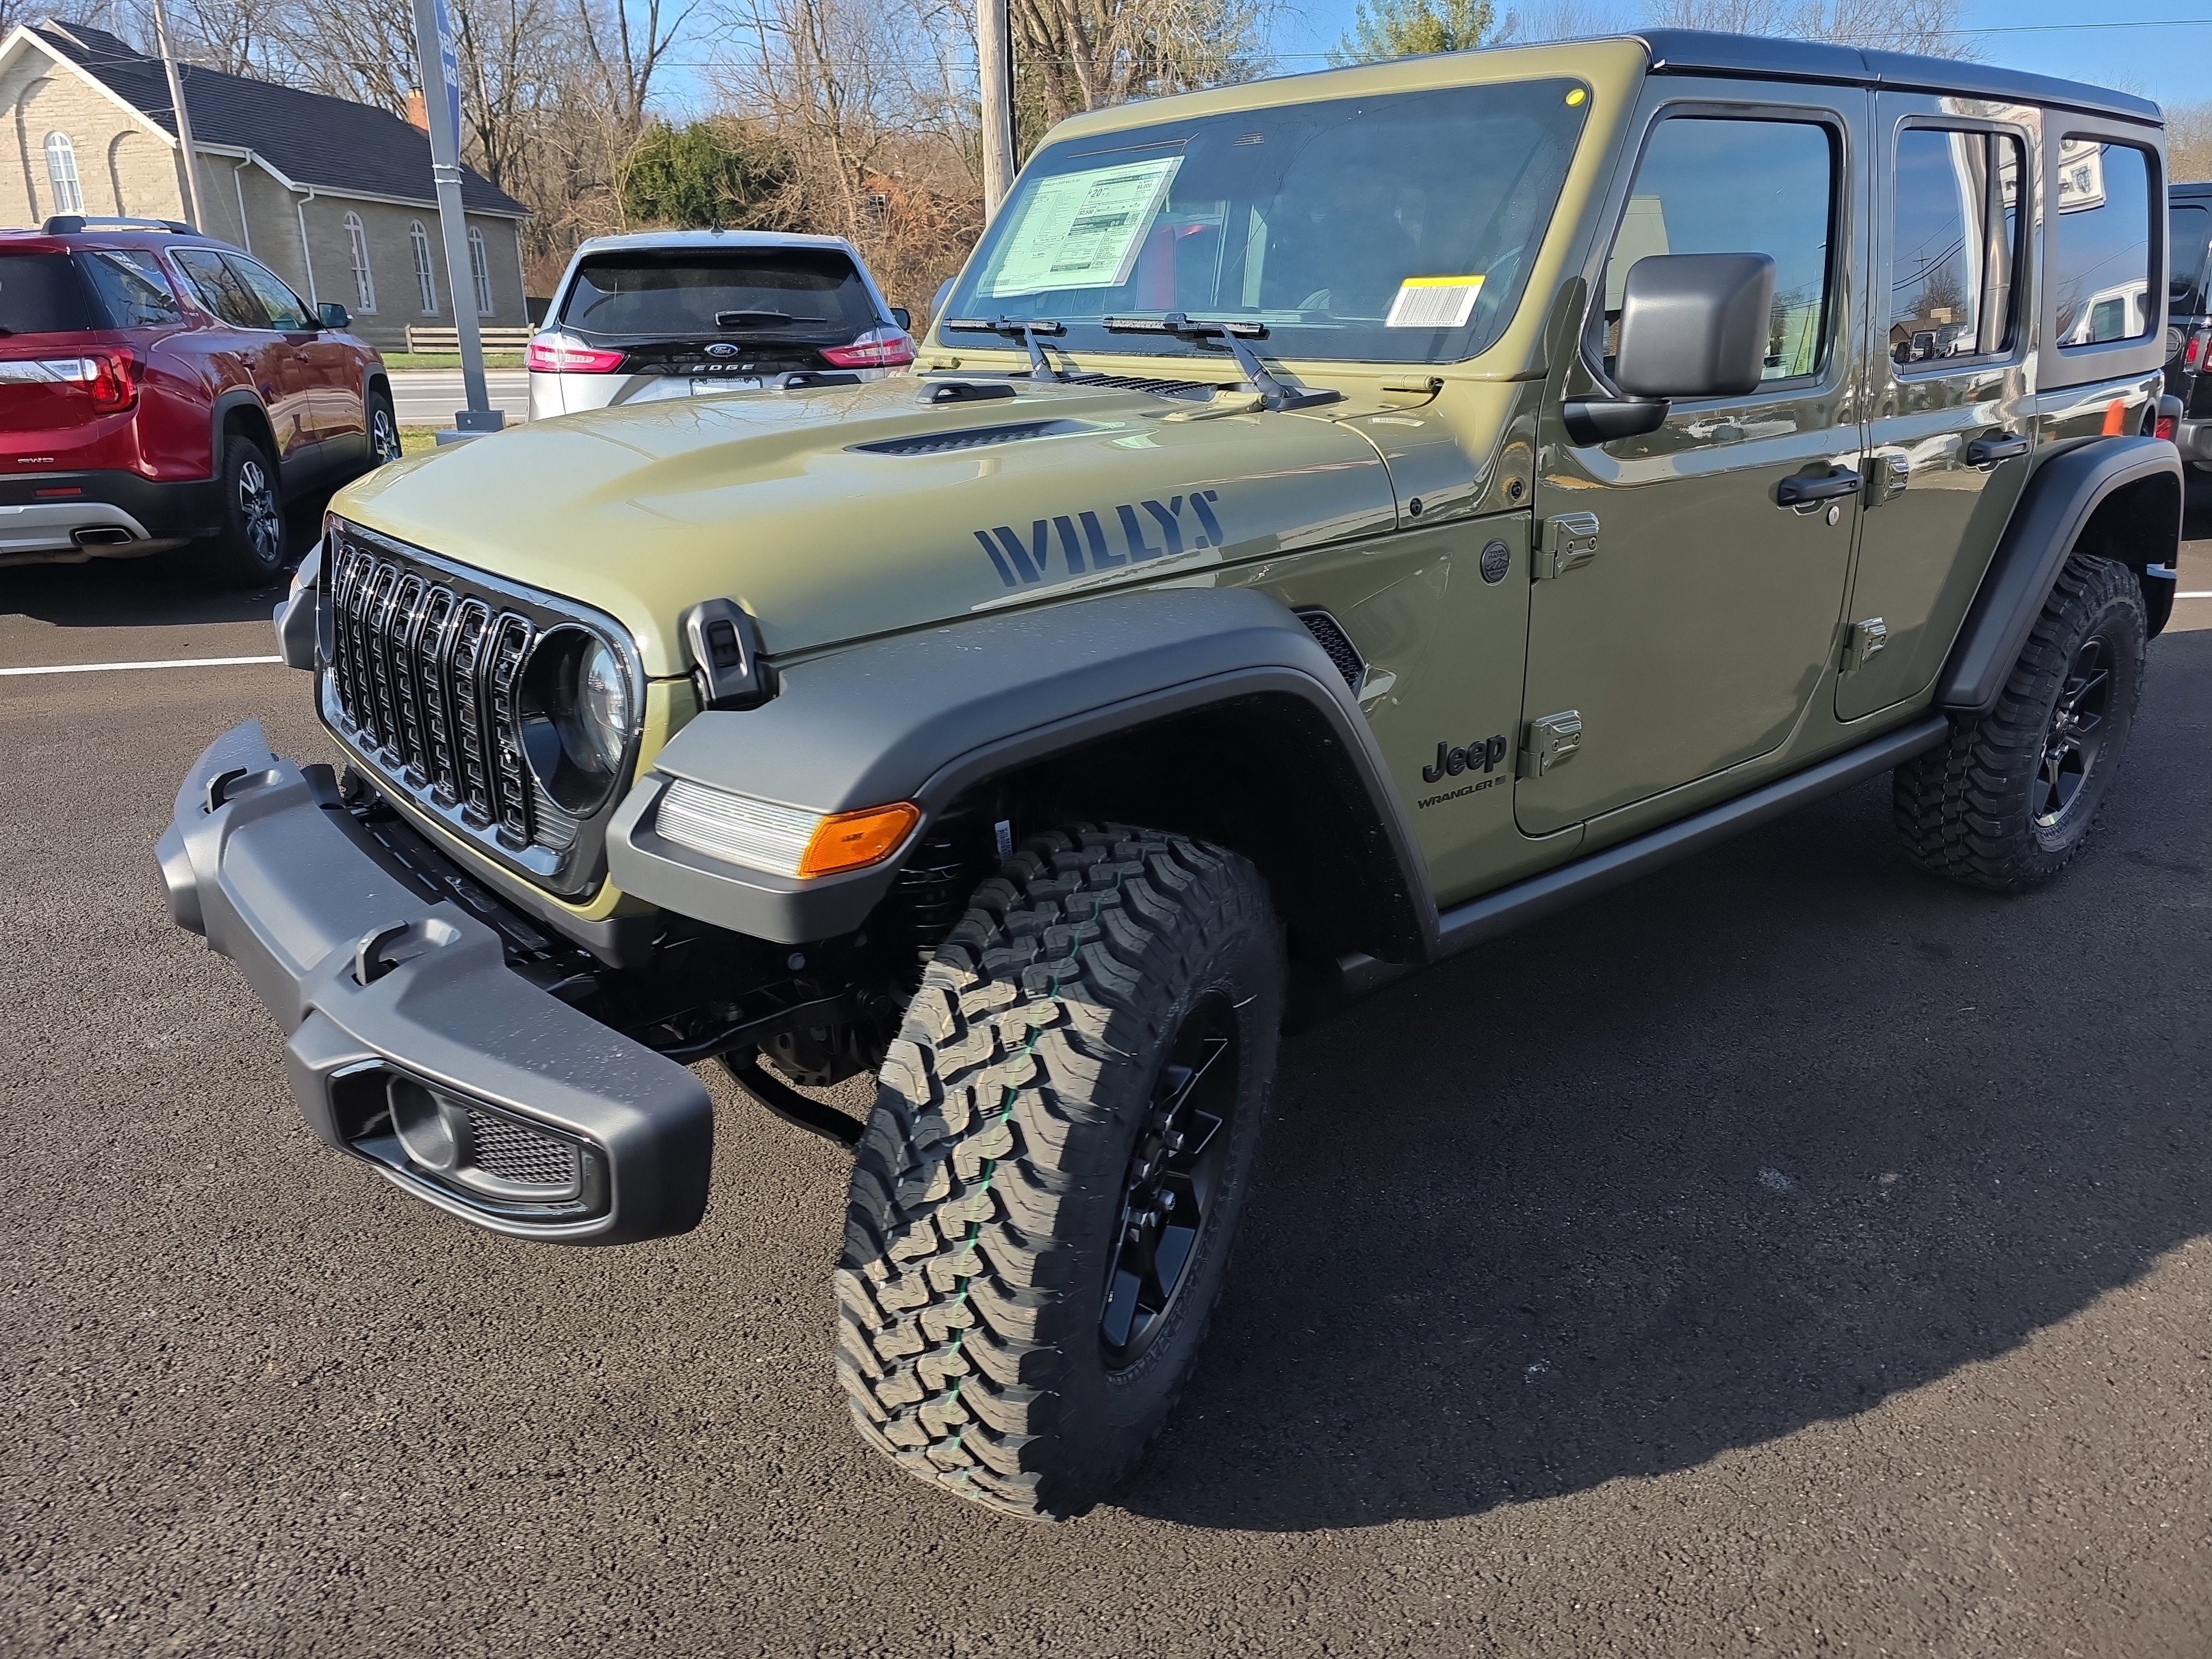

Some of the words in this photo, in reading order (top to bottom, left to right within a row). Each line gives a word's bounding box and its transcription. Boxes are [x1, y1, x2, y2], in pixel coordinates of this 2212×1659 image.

[1090, 188, 1103, 198] 20
[692, 363, 755, 372] EDGE
[973, 490, 1224, 587] WILLYS
[1422, 734, 1507, 783] Jeep
[1417, 779, 1493, 809] WRANGLER
